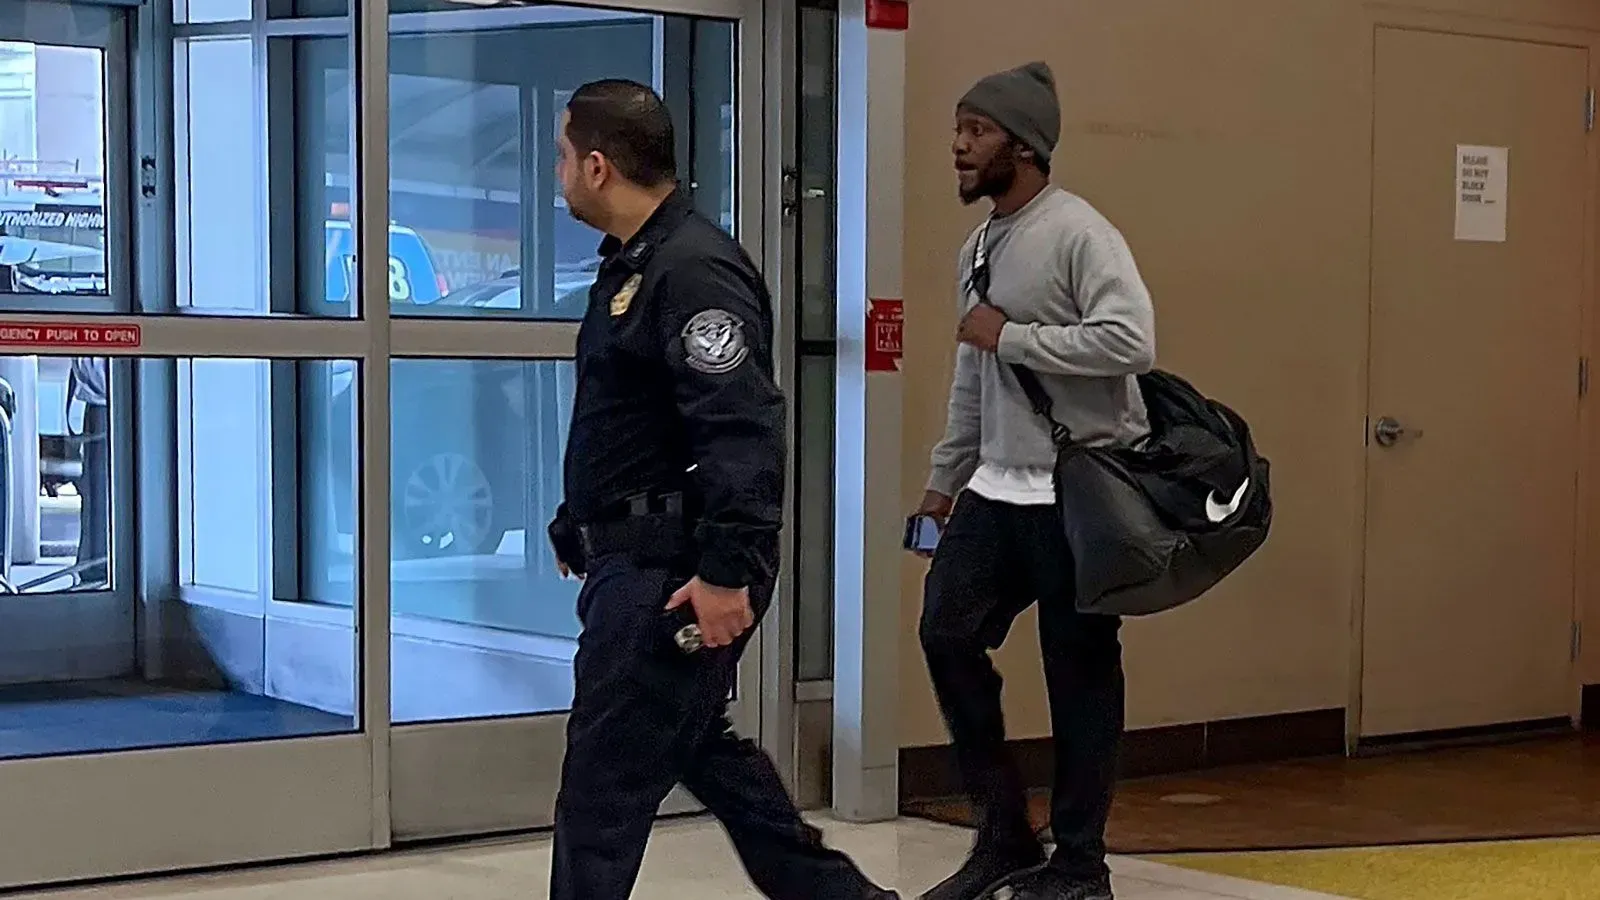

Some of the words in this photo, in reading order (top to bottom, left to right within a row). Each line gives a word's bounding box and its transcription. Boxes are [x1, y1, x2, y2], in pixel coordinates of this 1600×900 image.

[46, 328, 78, 341] PUSH
[83, 329, 99, 342] TO
[104, 330, 136, 342] OPEN
